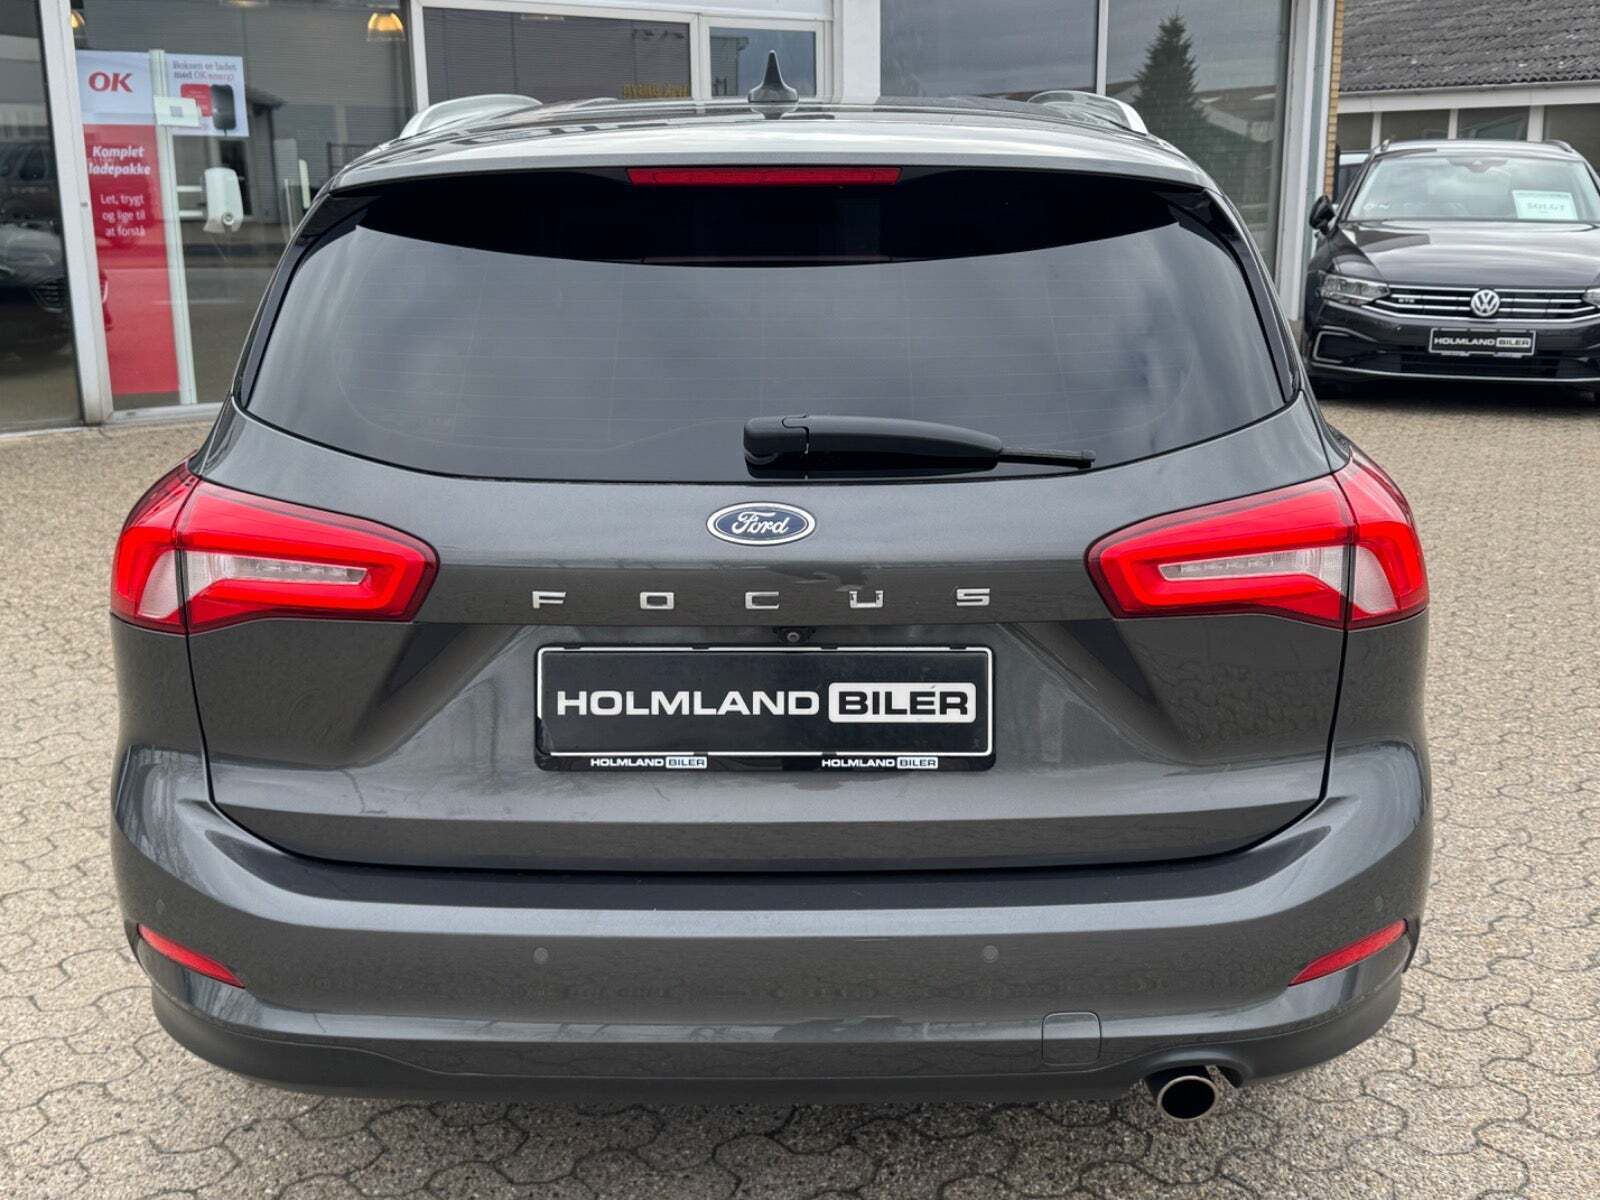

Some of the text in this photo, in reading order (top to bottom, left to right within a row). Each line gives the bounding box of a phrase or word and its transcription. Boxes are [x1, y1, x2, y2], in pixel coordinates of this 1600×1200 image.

[88, 71, 133, 93] OK
[92, 145, 145, 160] Komplet
[88, 162, 151, 178] ladepakke
[100, 194, 145, 207] Let, trygt
[102, 209, 146, 223] og lige til
[105, 225, 146, 237] at forstå
[1434, 337, 1495, 346] HOLMLAND
[731, 511, 790, 534] Ford
[532, 588, 991, 610] FOCUS
[557, 690, 969, 716] HOLMLAND BILER
[590, 758, 706, 768] HOLMLAND BILER
[821, 758, 937, 768] HOLMLAND BILER
